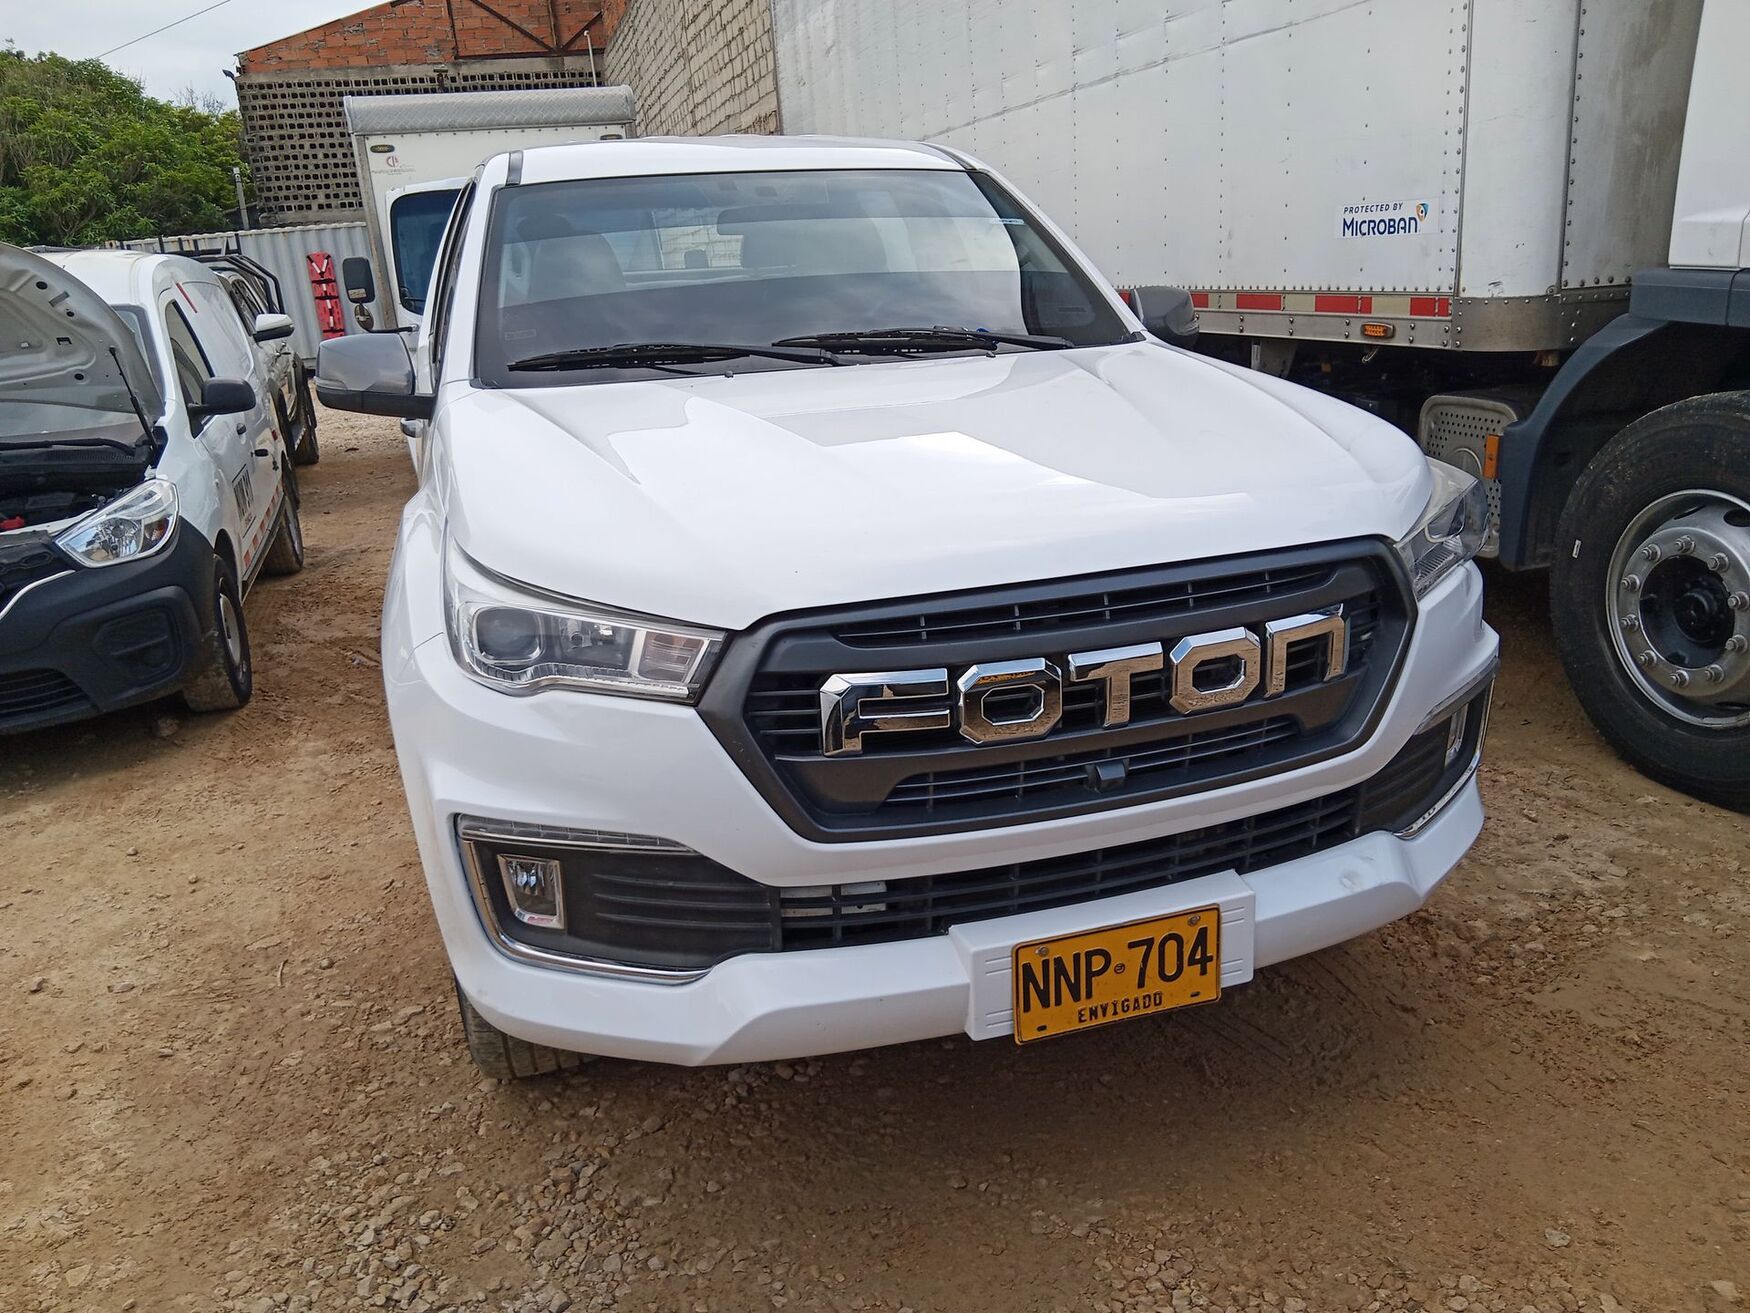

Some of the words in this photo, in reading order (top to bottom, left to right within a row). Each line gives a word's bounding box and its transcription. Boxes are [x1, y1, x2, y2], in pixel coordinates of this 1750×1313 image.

[1343, 203, 1390, 214] PROTECTED
[1392, 202, 1403, 211] BY
[819, 603, 1350, 757] FOTON
[1021, 948, 1112, 1013] NNP
[1127, 926, 1214, 989] 704
[1077, 991, 1163, 1024] ENVIGADO
